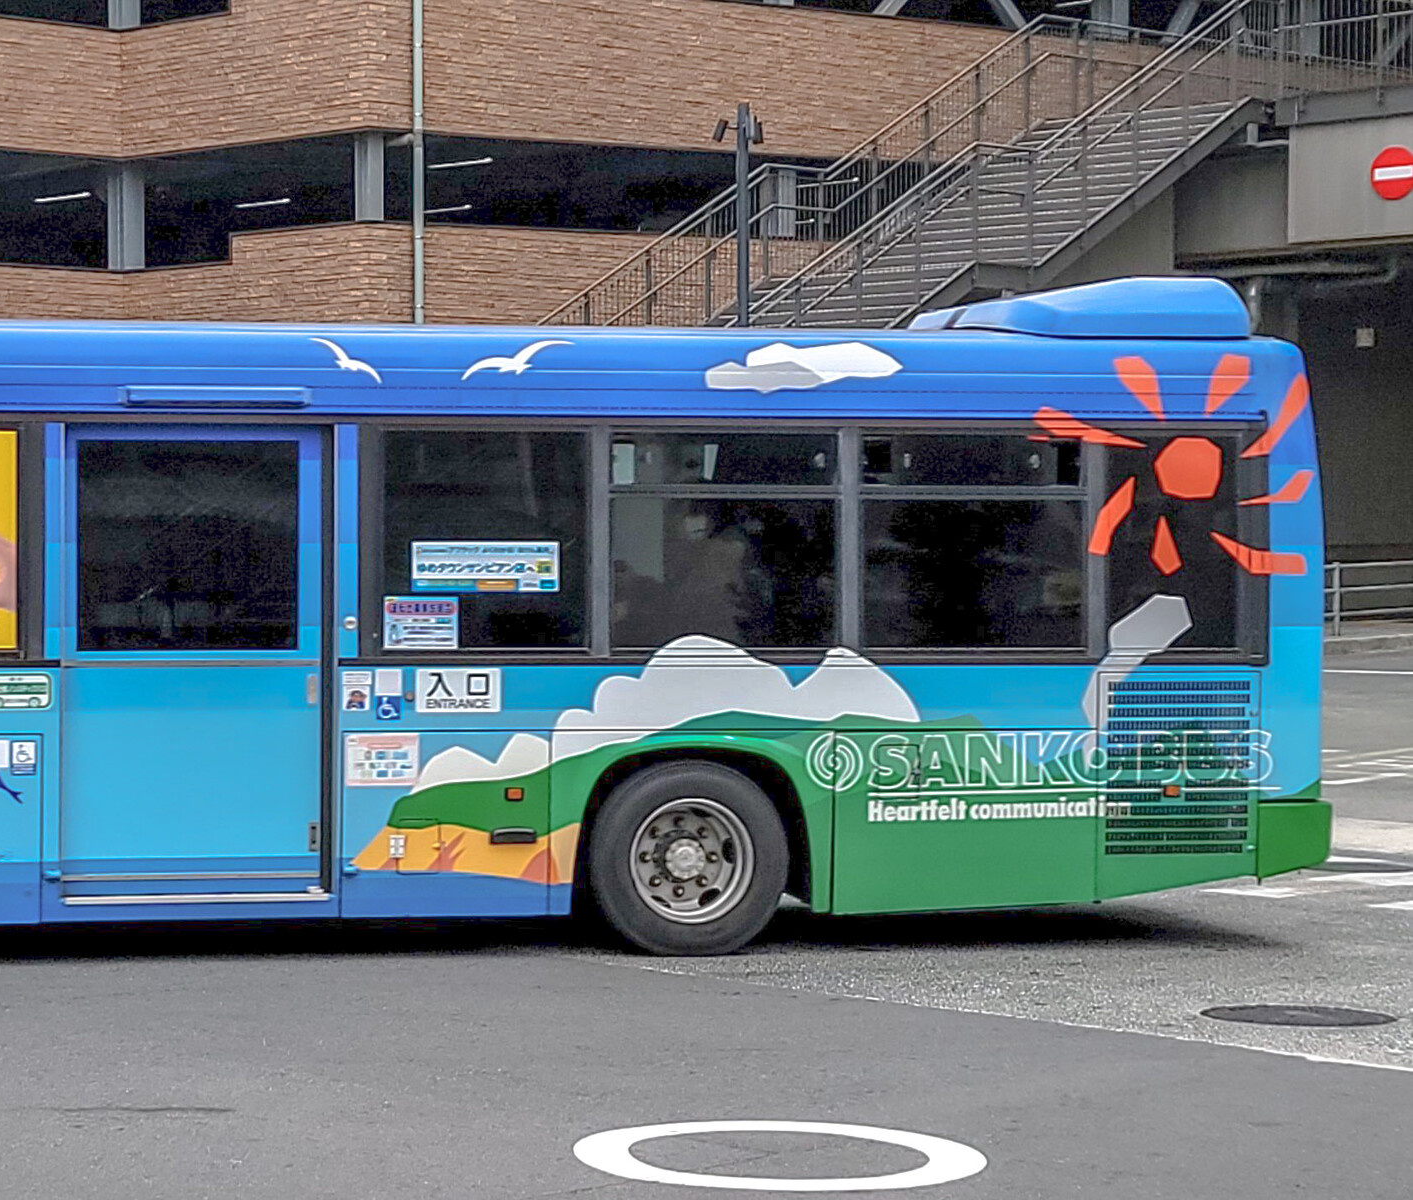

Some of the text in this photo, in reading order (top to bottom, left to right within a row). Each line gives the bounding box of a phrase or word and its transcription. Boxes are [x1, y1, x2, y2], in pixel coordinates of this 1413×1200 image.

[426, 672, 490, 697] 入口
[424, 698, 491, 710] ENTRANCE
[867, 731, 1124, 789] SANKO
[867, 798, 967, 822] Heartfelt
